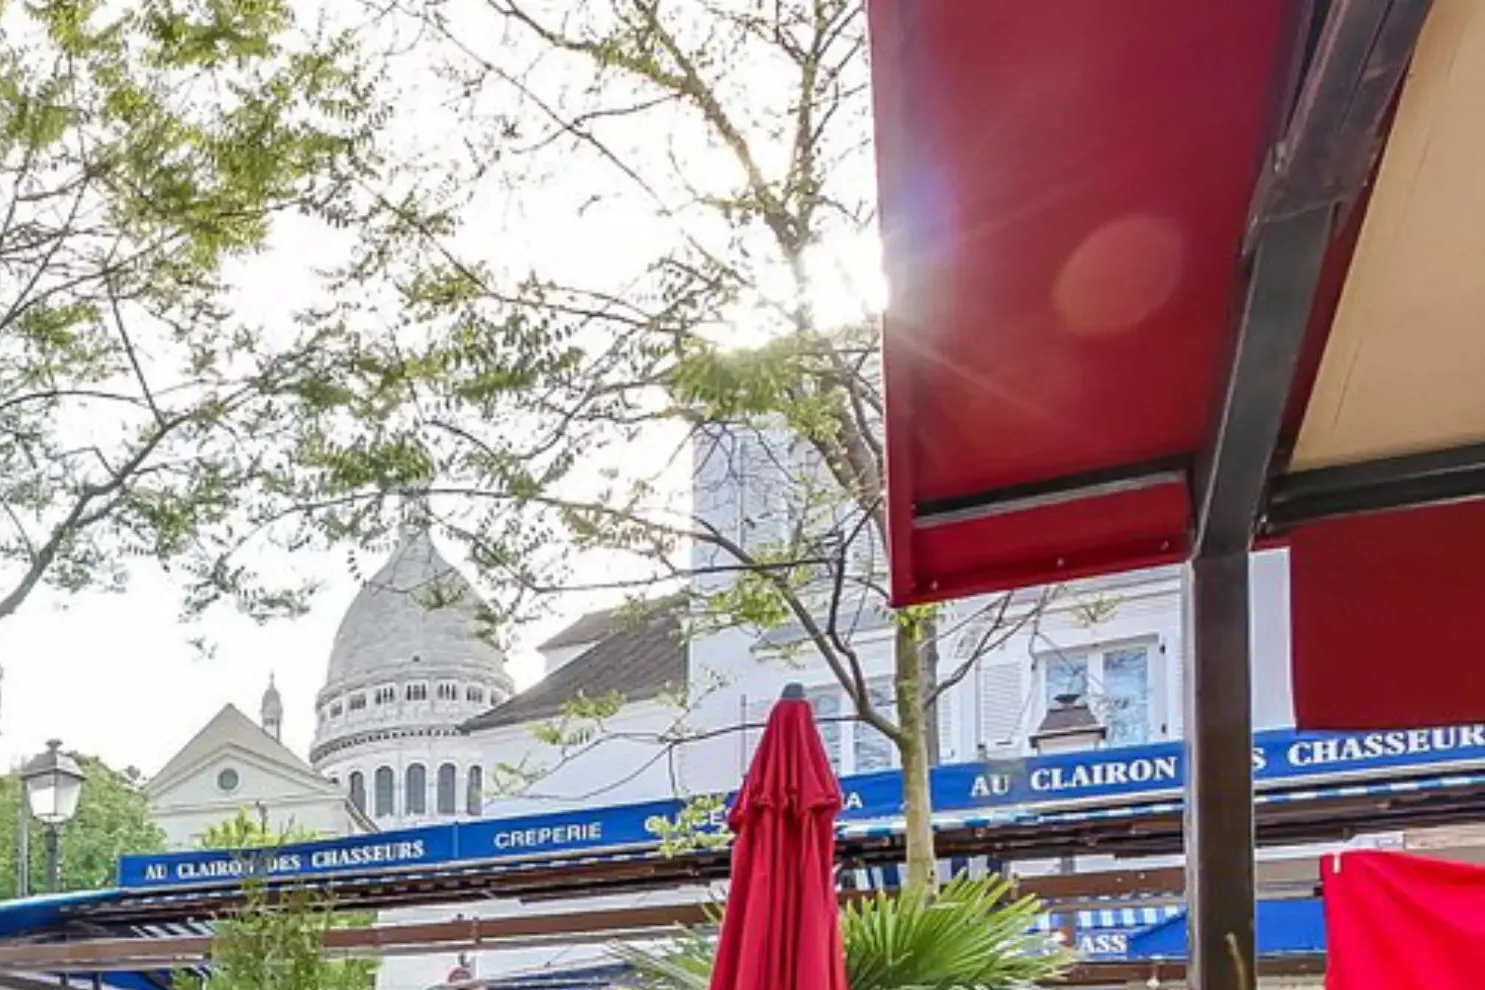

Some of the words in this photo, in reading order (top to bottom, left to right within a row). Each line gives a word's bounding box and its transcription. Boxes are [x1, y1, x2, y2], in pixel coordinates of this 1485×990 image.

[970, 775, 1010, 797] AU
[1030, 756, 1178, 792] CLAIRON
[493, 821, 603, 849] CREPERIE
[145, 863, 167, 880] AU
[312, 841, 425, 868] CHASSEURS
